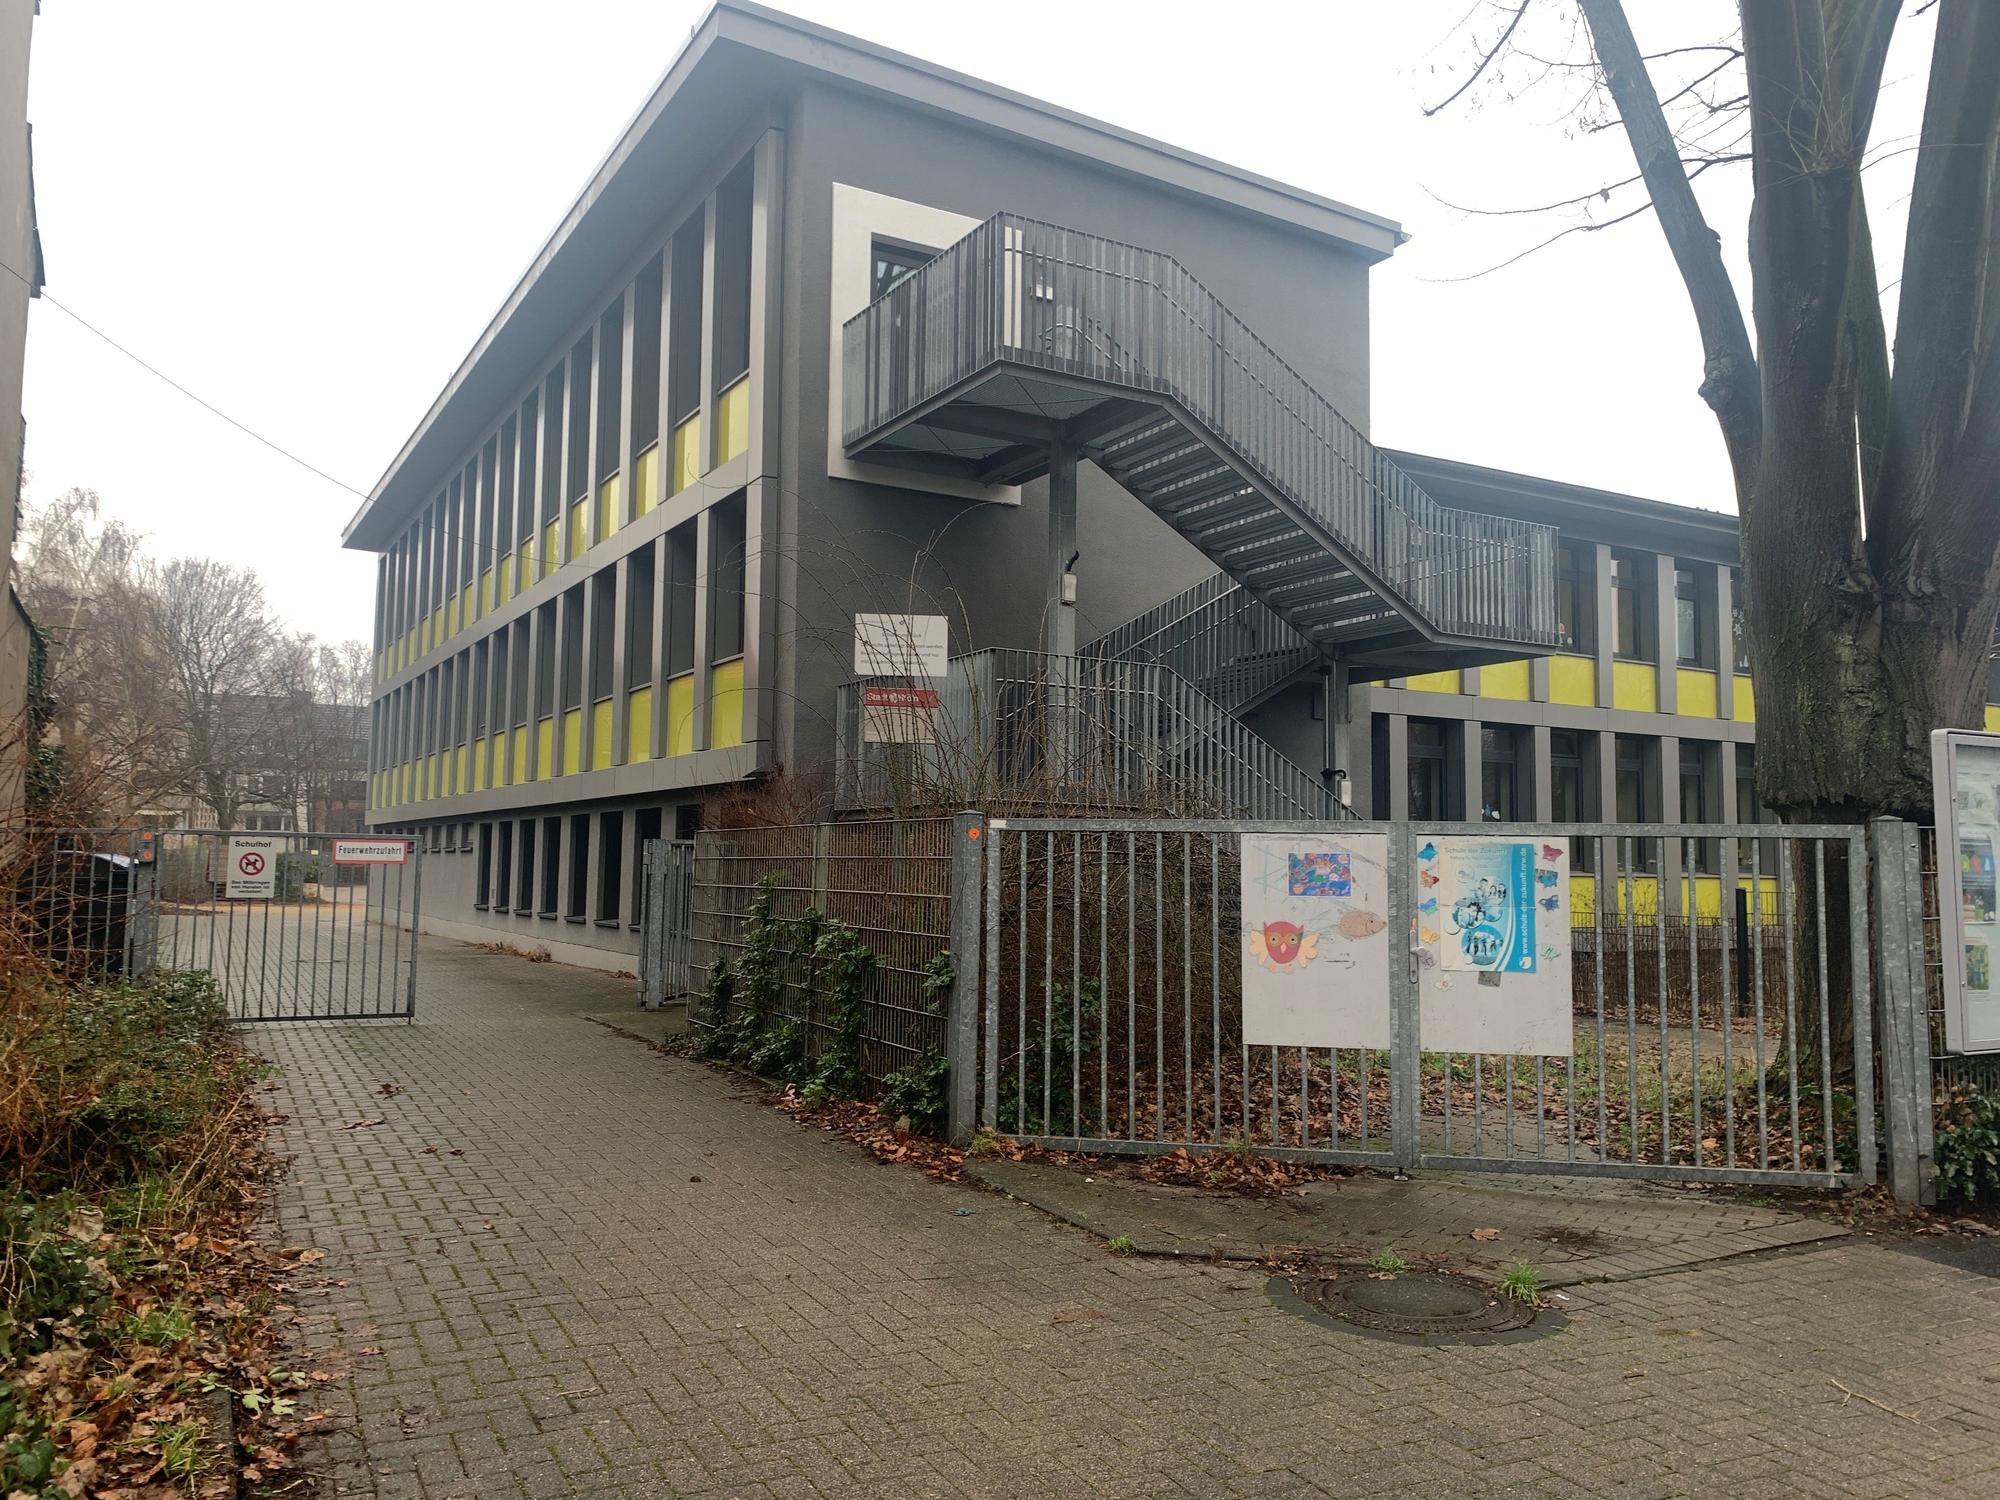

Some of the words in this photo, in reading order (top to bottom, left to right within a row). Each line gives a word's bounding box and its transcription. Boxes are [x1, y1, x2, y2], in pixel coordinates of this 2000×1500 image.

[898, 693, 919, 702] Kön
[235, 840, 272, 848] Schulhof
[338, 845, 402, 855] Feuerwehrzufahrt
[1519, 847, 1528, 955] www.schule-der-zukunft.nrw.de
